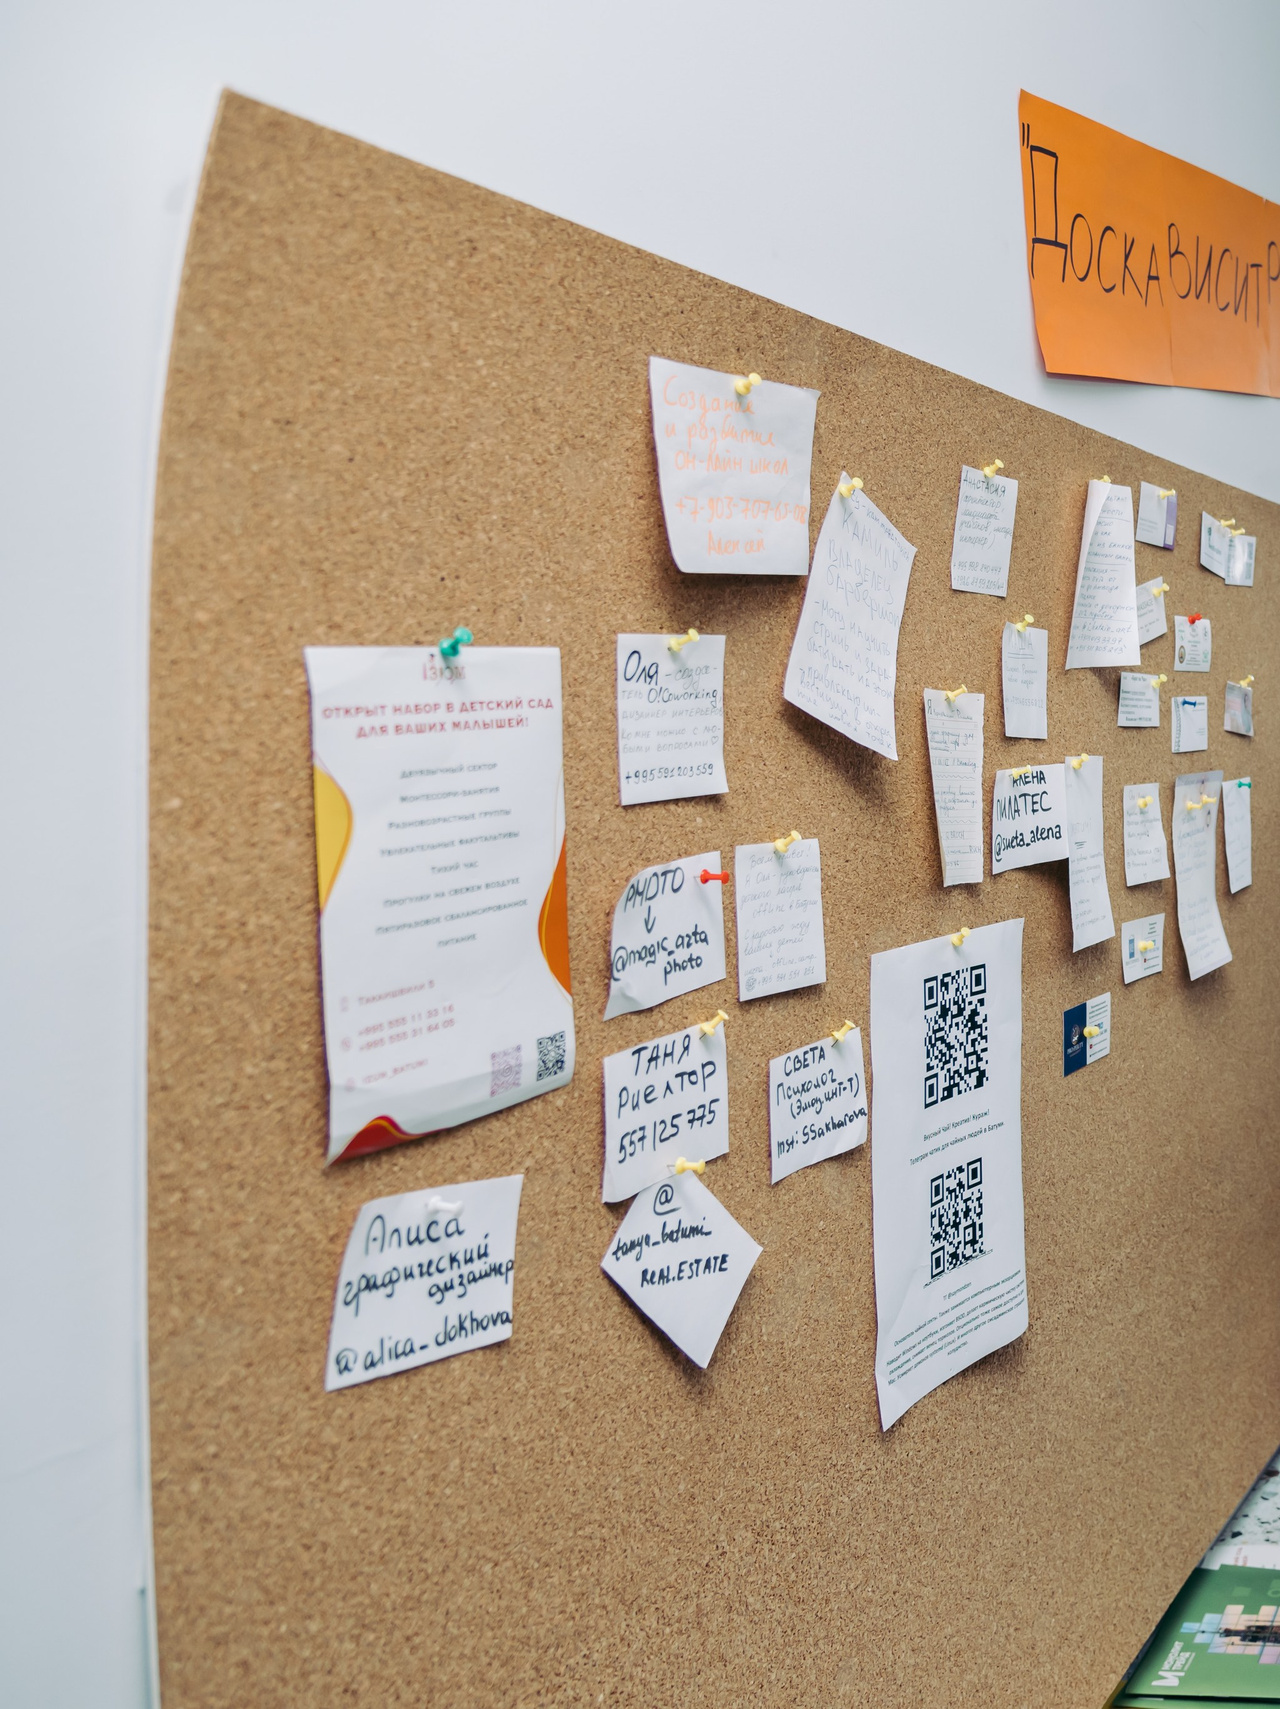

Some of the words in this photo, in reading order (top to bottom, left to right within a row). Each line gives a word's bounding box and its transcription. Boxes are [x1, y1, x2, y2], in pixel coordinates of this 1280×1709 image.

[665, 423, 676, 438] и
[623, 650, 660, 686] Оля
[322, 704, 388, 720] ОТКРЫТ
[393, 703, 442, 716] НАБОР
[446, 702, 455, 713] В
[459, 697, 523, 713] ДЕТСКИЙ
[528, 698, 554, 710] САД
[356, 724, 389, 739] ДЛЯ
[395, 722, 447, 735] ВАШИХ
[452, 716, 530, 731] МАЛЫШЕЙ!
[996, 791, 1052, 821] ПИЛАТЕС
[624, 867, 685, 912] PHOTO
[663, 954, 702, 986] photo
[631, 1033, 691, 1076] ТАНЯ
[784, 1045, 826, 1077] СВЕТА
[776, 1068, 837, 1106] Психолог
[653, 1183, 682, 1216] @
[365, 1214, 465, 1256] Алиса
[343, 1232, 490, 1317] графический
[428, 1258, 515, 1305] дизайнер
